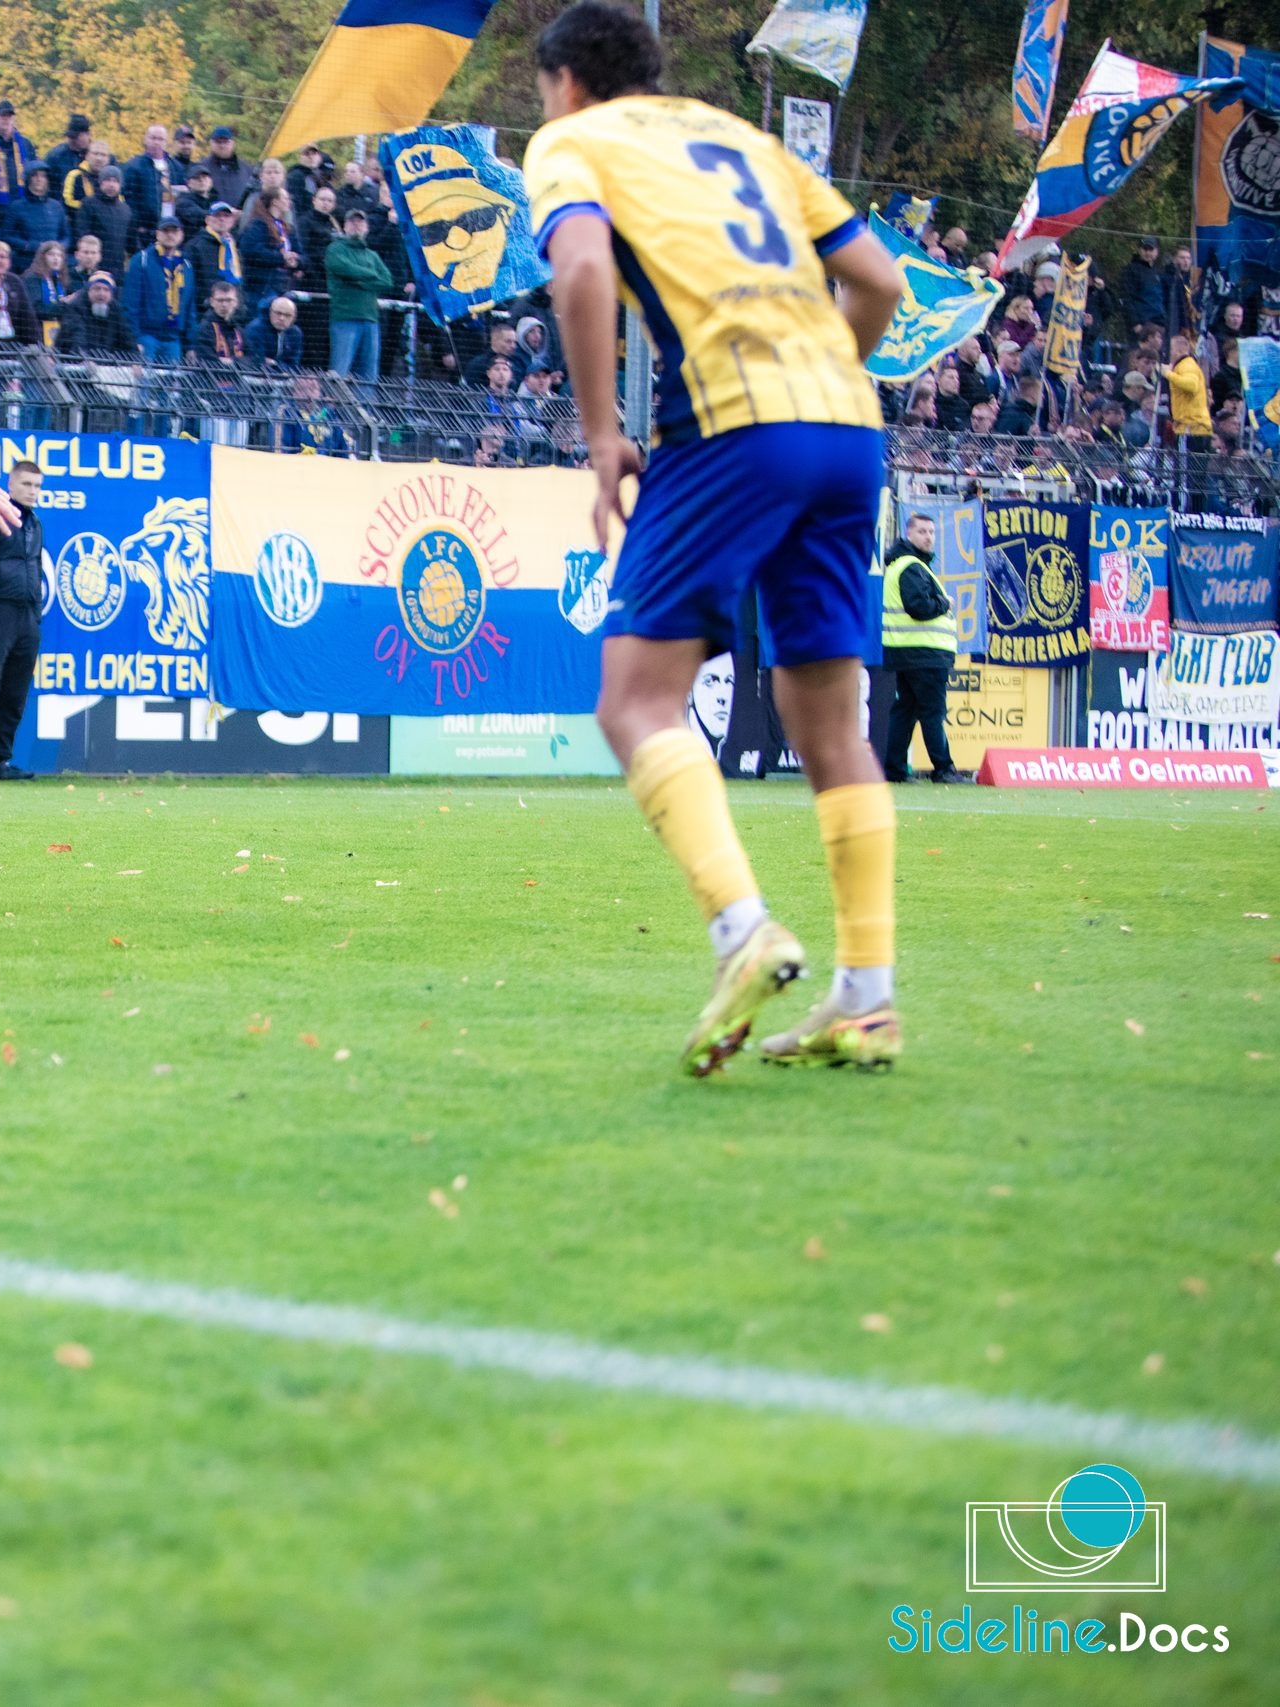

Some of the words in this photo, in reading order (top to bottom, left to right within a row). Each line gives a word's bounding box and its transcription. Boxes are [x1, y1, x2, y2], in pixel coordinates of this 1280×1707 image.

[401, 149, 436, 176] LOK
[686, 139, 794, 270] 3
[33, 490, 87, 510] 023
[1089, 510, 1168, 551] LOK
[988, 626, 1091, 663] OCKREHNA
[1090, 619, 1169, 652] HALLE
[84, 650, 209, 694] LOKISTEN
[374, 624, 417, 683] ON
[431, 621, 511, 705] TOUR
[1219, 634, 1276, 688] CLUB
[946, 674, 980, 688] UTO
[1088, 710, 1204, 751] FOOTBALL
[1007, 755, 1122, 783] nahkauf
[1128, 757, 1253, 784] Oelmann
